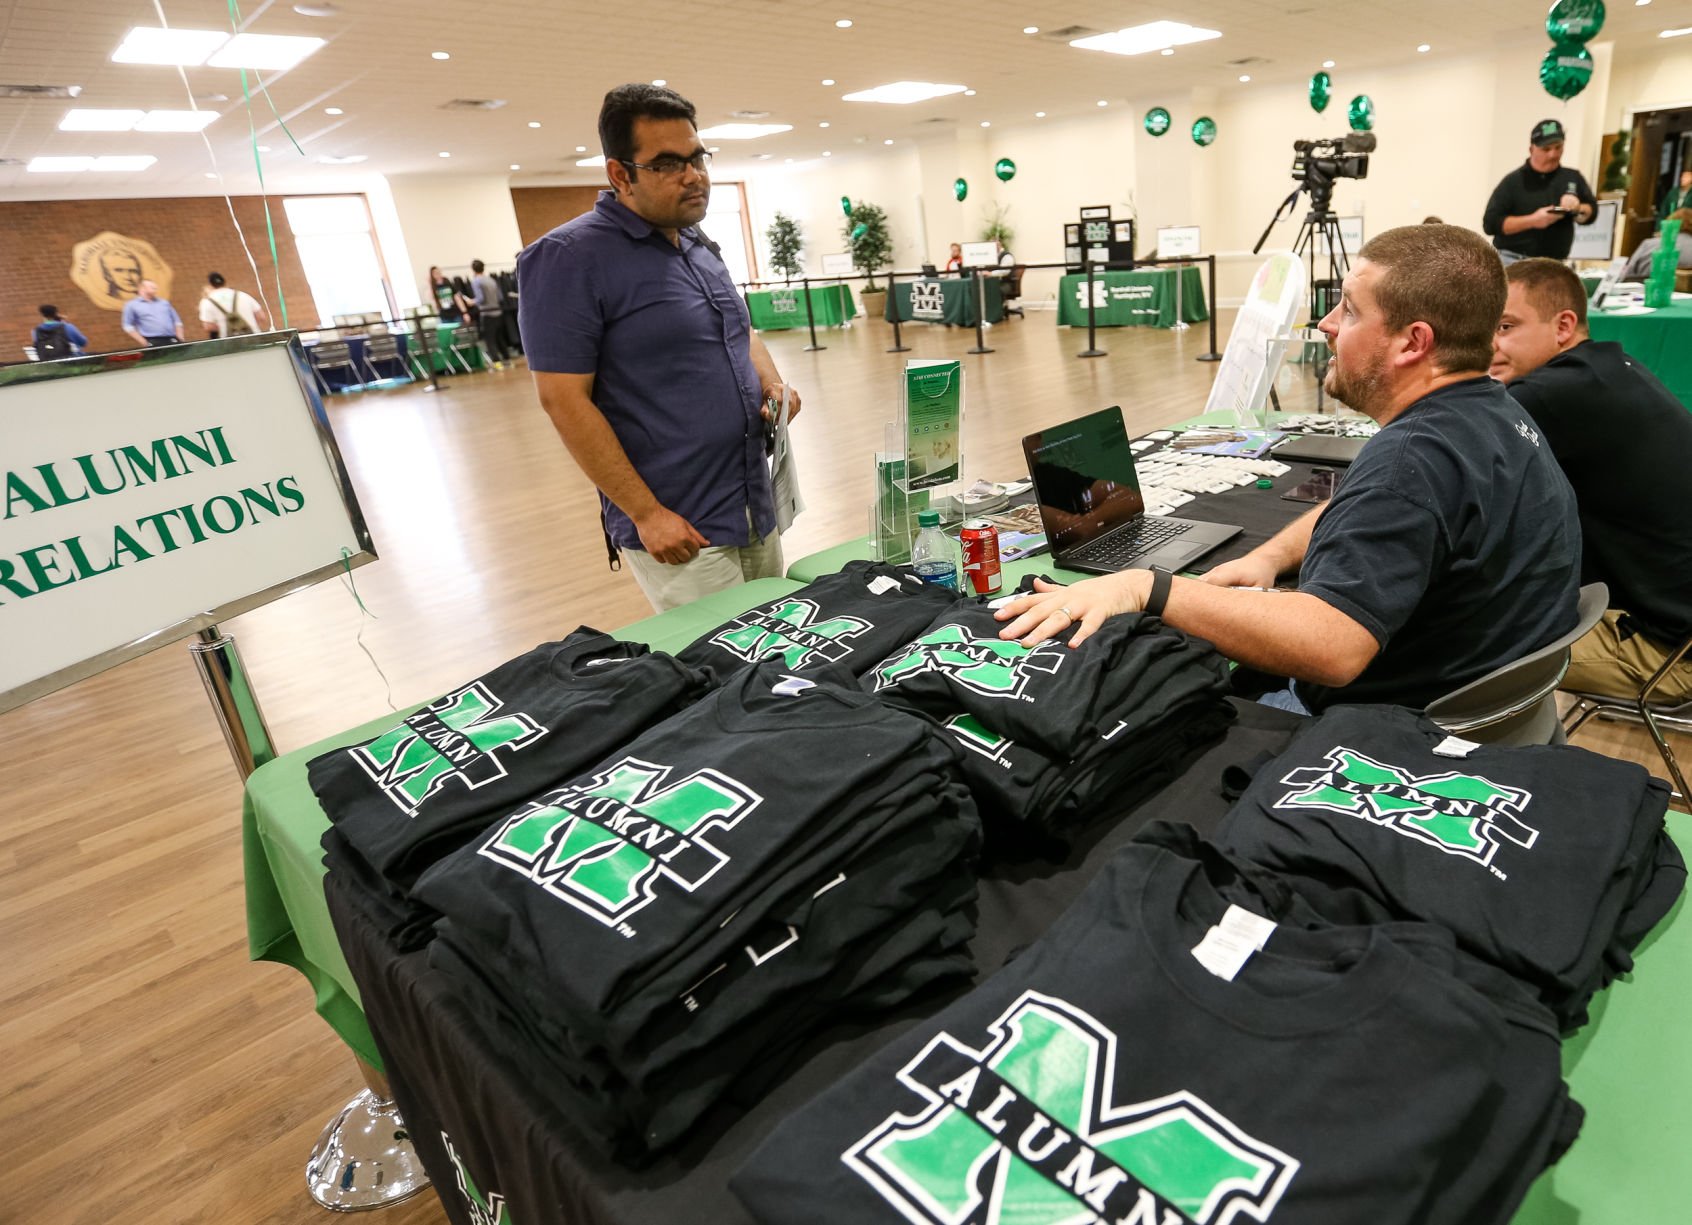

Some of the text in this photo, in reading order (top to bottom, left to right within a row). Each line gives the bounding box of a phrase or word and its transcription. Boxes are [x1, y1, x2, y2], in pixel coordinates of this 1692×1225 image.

[3, 426, 237, 520] ALUMNI
[998, 757, 1013, 770] TM
[1312, 772, 1500, 824] ALUMNI
[1489, 864, 1508, 881] TM
[615, 921, 637, 939] TM
